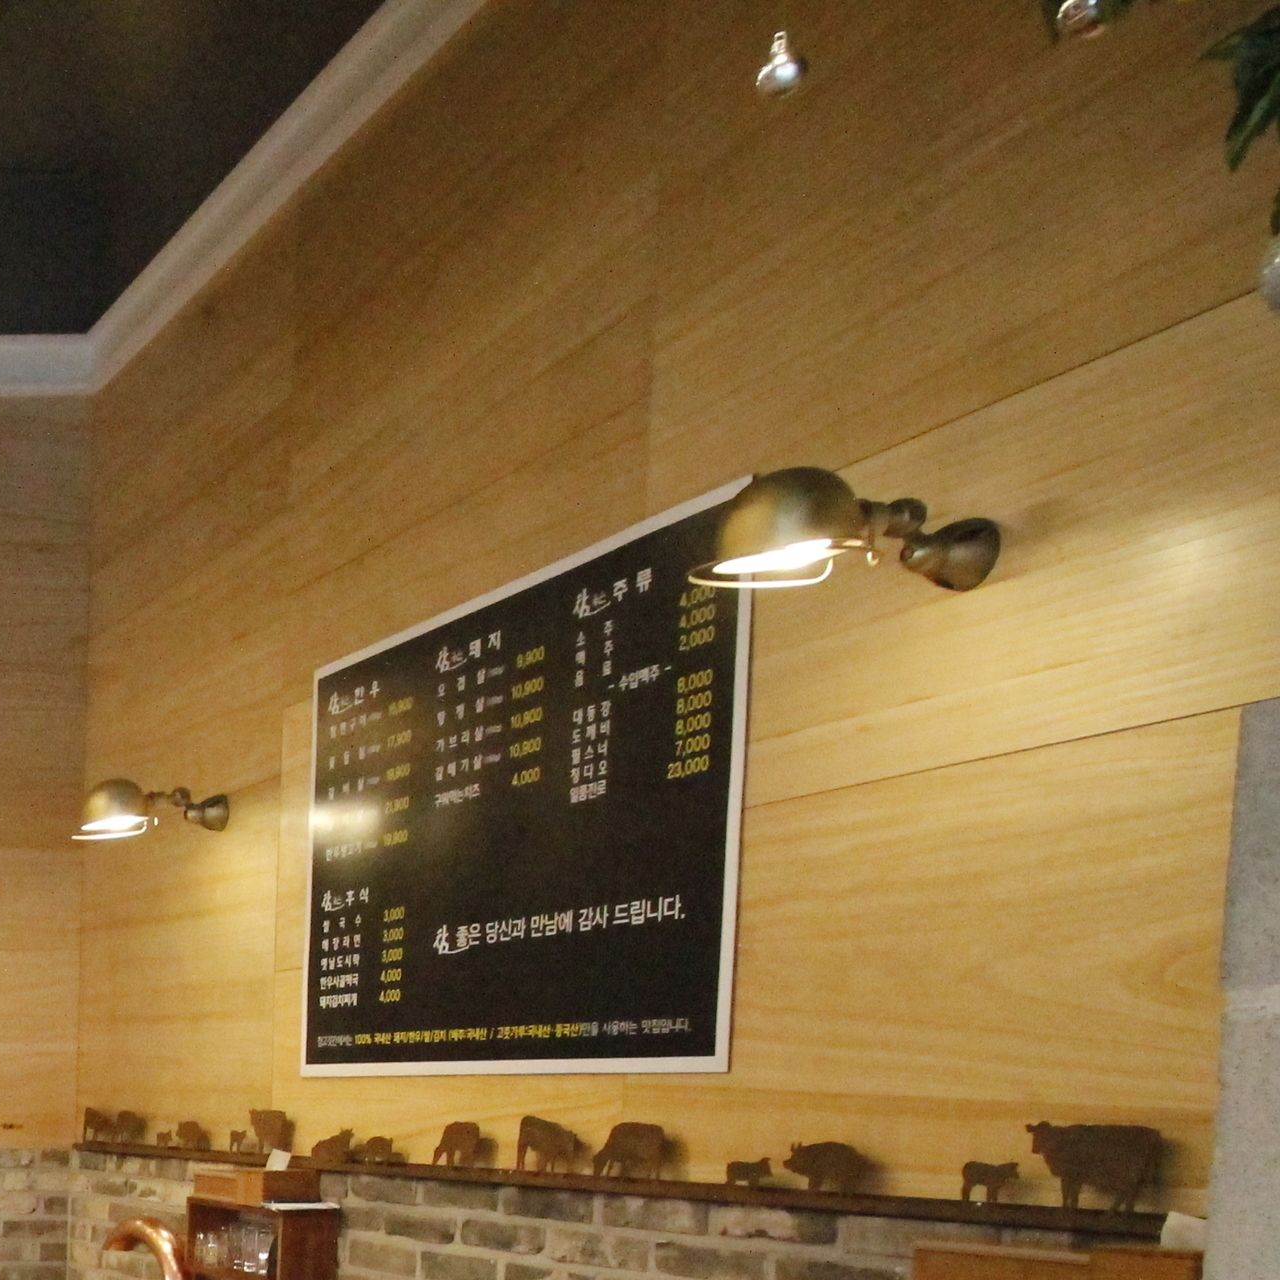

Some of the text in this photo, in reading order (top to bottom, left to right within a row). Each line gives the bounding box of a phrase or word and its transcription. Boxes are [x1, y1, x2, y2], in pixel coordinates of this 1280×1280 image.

[613, 568, 652, 602] 주류
[576, 586, 716, 646] 소주 4,000
[469, 630, 501, 658] 돼지
[575, 604, 716, 665] 맥주 4,000
[517, 645, 545, 669] 9,900
[574, 625, 716, 687] 음료 2,000
[512, 676, 544, 699] 10,900
[619, 664, 660, 691] 수입맥주
[355, 681, 380, 705] 한우
[572, 668, 714, 725] 대동강 8,000
[436, 725, 484, 752] 가브리살
[510, 707, 543, 729] 10,900
[572, 690, 713, 744] 도깨비 8,000
[571, 711, 712, 765] 필스너 8,000
[675, 733, 711, 758] 7,000
[435, 754, 482, 781] 갈매기살
[509, 737, 541, 759] 10,900
[511, 766, 540, 786] 4,000
[569, 755, 710, 803] 일품진로 23,000
[345, 887, 370, 907] 후식
[383, 907, 405, 922] 3,000
[455, 924, 482, 950] 좋은
[485, 917, 526, 944] 당신과
[531, 910, 573, 938] 만남에
[578, 904, 608, 930] 감사
[612, 894, 686, 926] 드립니다.
[382, 927, 404, 943] 3,000
[320, 948, 403, 972] 옛날도시락 3,000
[380, 968, 402, 984] 4,000
[379, 989, 401, 1004] 4,000
[353, 1032, 372, 1046] 100%
[373, 1031, 391, 1045] 국내산
[601, 1019, 637, 1037] 사용하는
